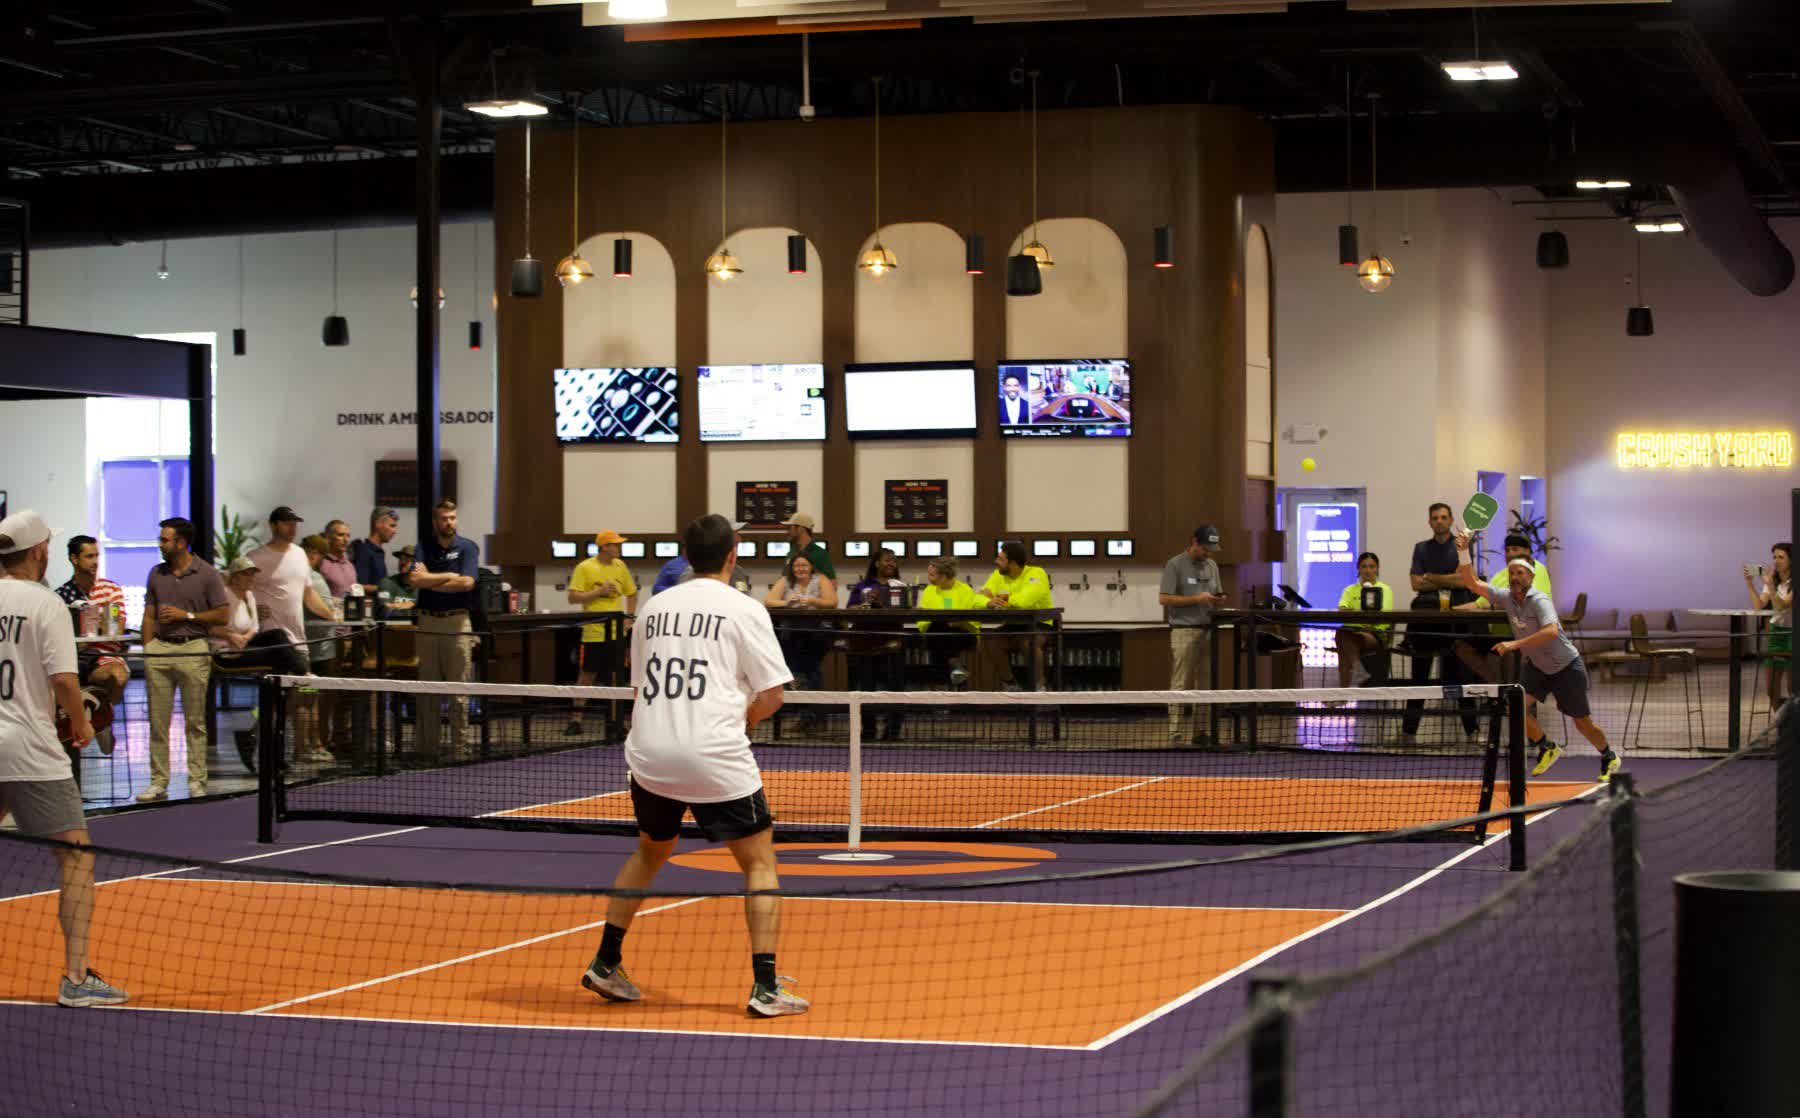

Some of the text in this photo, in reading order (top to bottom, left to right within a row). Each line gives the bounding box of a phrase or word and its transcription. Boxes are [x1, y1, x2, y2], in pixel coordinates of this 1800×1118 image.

[337, 411, 494, 426] DRINK AMSSADO
[1616, 431, 1792, 468] CRUSH YARD
[645, 612, 727, 641] BILL DIT
[643, 652, 708, 705] $65
